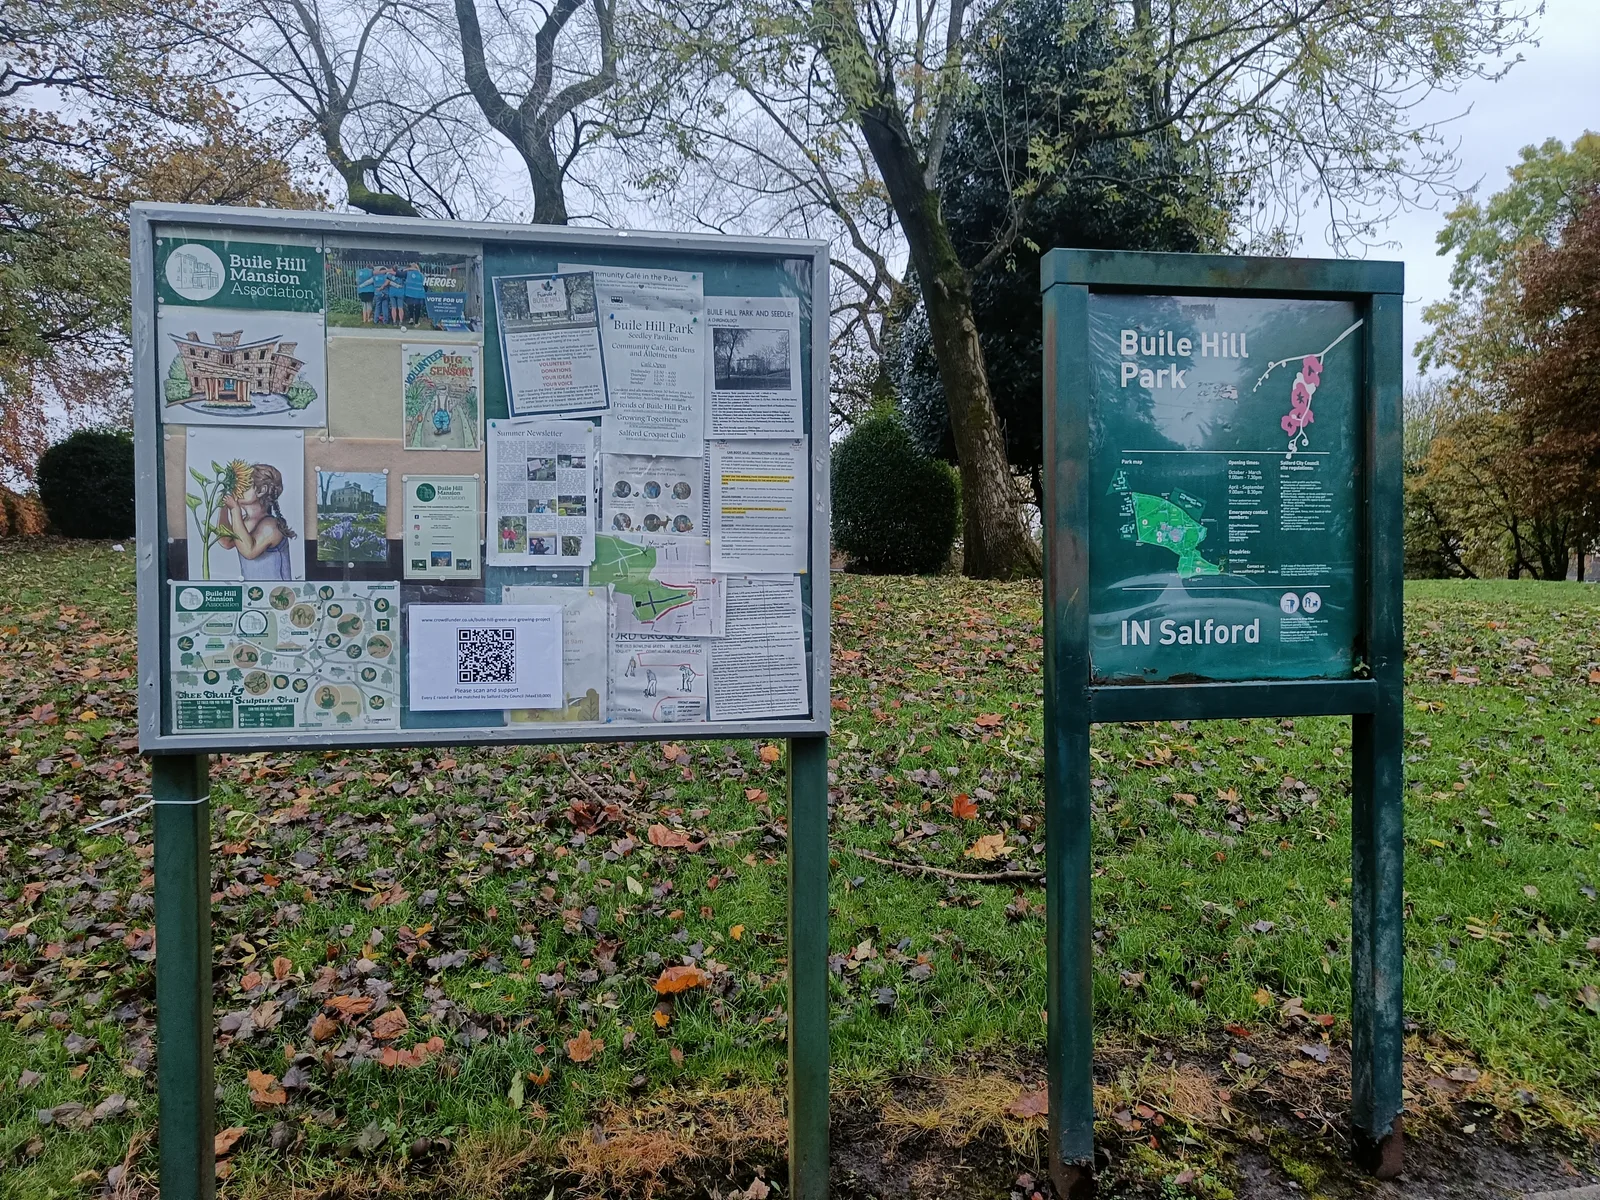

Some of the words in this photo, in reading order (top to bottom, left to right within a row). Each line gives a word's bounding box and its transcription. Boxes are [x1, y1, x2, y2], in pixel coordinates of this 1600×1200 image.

[230, 254, 272, 269] Buile
[276, 257, 306, 272] Hill
[230, 268, 300, 284] Mansion
[423, 277, 456, 287] HEROES
[231, 282, 314, 299] Association
[614, 320, 642, 330] Buile
[646, 320, 665, 331] Hill
[669, 323, 694, 334] Park
[612, 343, 649, 351] Community
[669, 345, 695, 353] Gardens
[1120, 330, 1192, 357] Buile
[1201, 332, 1249, 358] Hill
[644, 350, 677, 359] Allotments
[405, 349, 446, 384] VOLUNTEER
[430, 366, 474, 377] SENSORY
[1120, 362, 1187, 389] Park
[617, 414, 645, 423] Growing
[646, 416, 688, 424] Togetherness
[1121, 620, 1150, 645] IN
[1159, 618, 1260, 645] Salford
[235, 696, 274, 705] Sculpture
